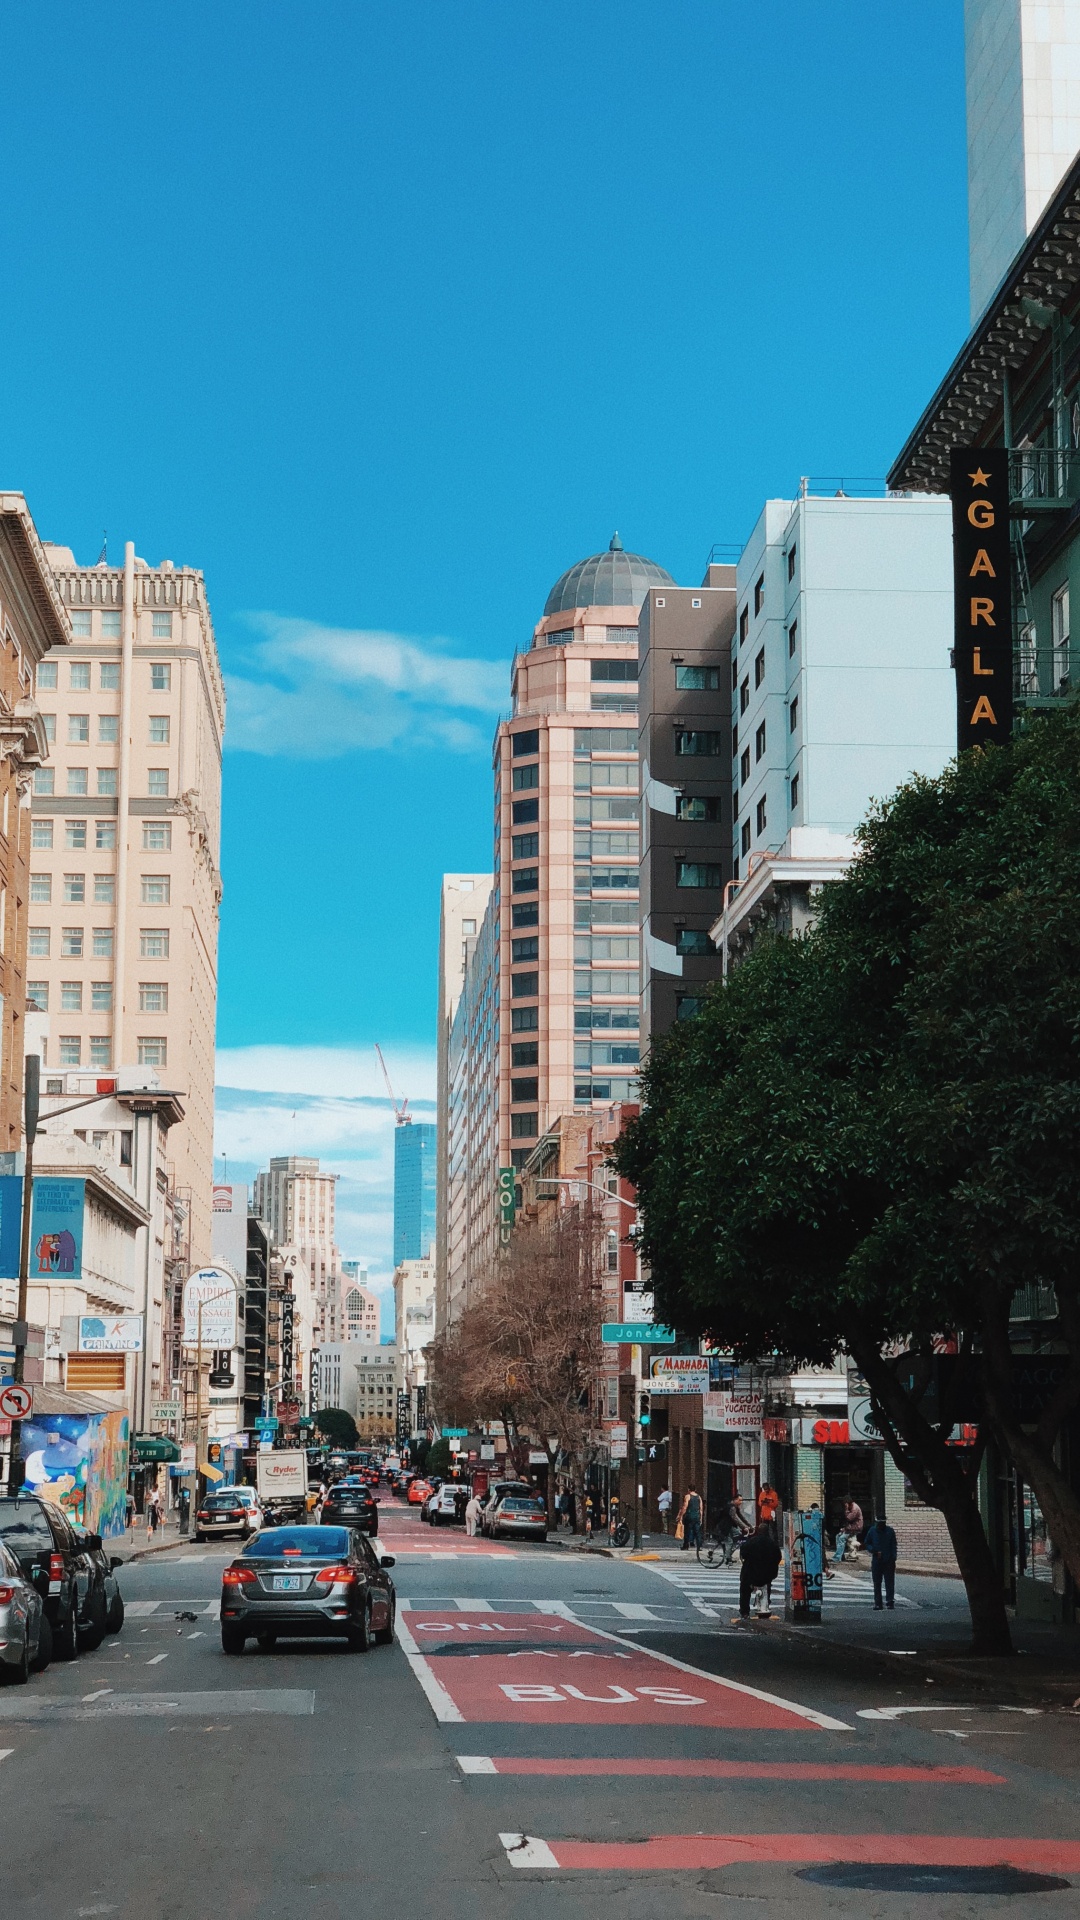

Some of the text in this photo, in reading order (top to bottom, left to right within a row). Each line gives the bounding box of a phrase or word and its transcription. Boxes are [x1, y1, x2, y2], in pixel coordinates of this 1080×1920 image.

[967, 499, 998, 726] GARLA
[189, 1286, 232, 1300] EMPIRE
[187, 1308, 232, 1317] MSSAGE
[616, 1328, 661, 1338] Jones
[663, 1357, 709, 1370] MARHABA
[155, 1409, 177, 1417] INN
[725, 1404, 762, 1413] YUCATECO
[273, 1466, 298, 1475] Ryder
[415, 1622, 566, 1633] ONLY
[498, 1684, 708, 1706] BUS
